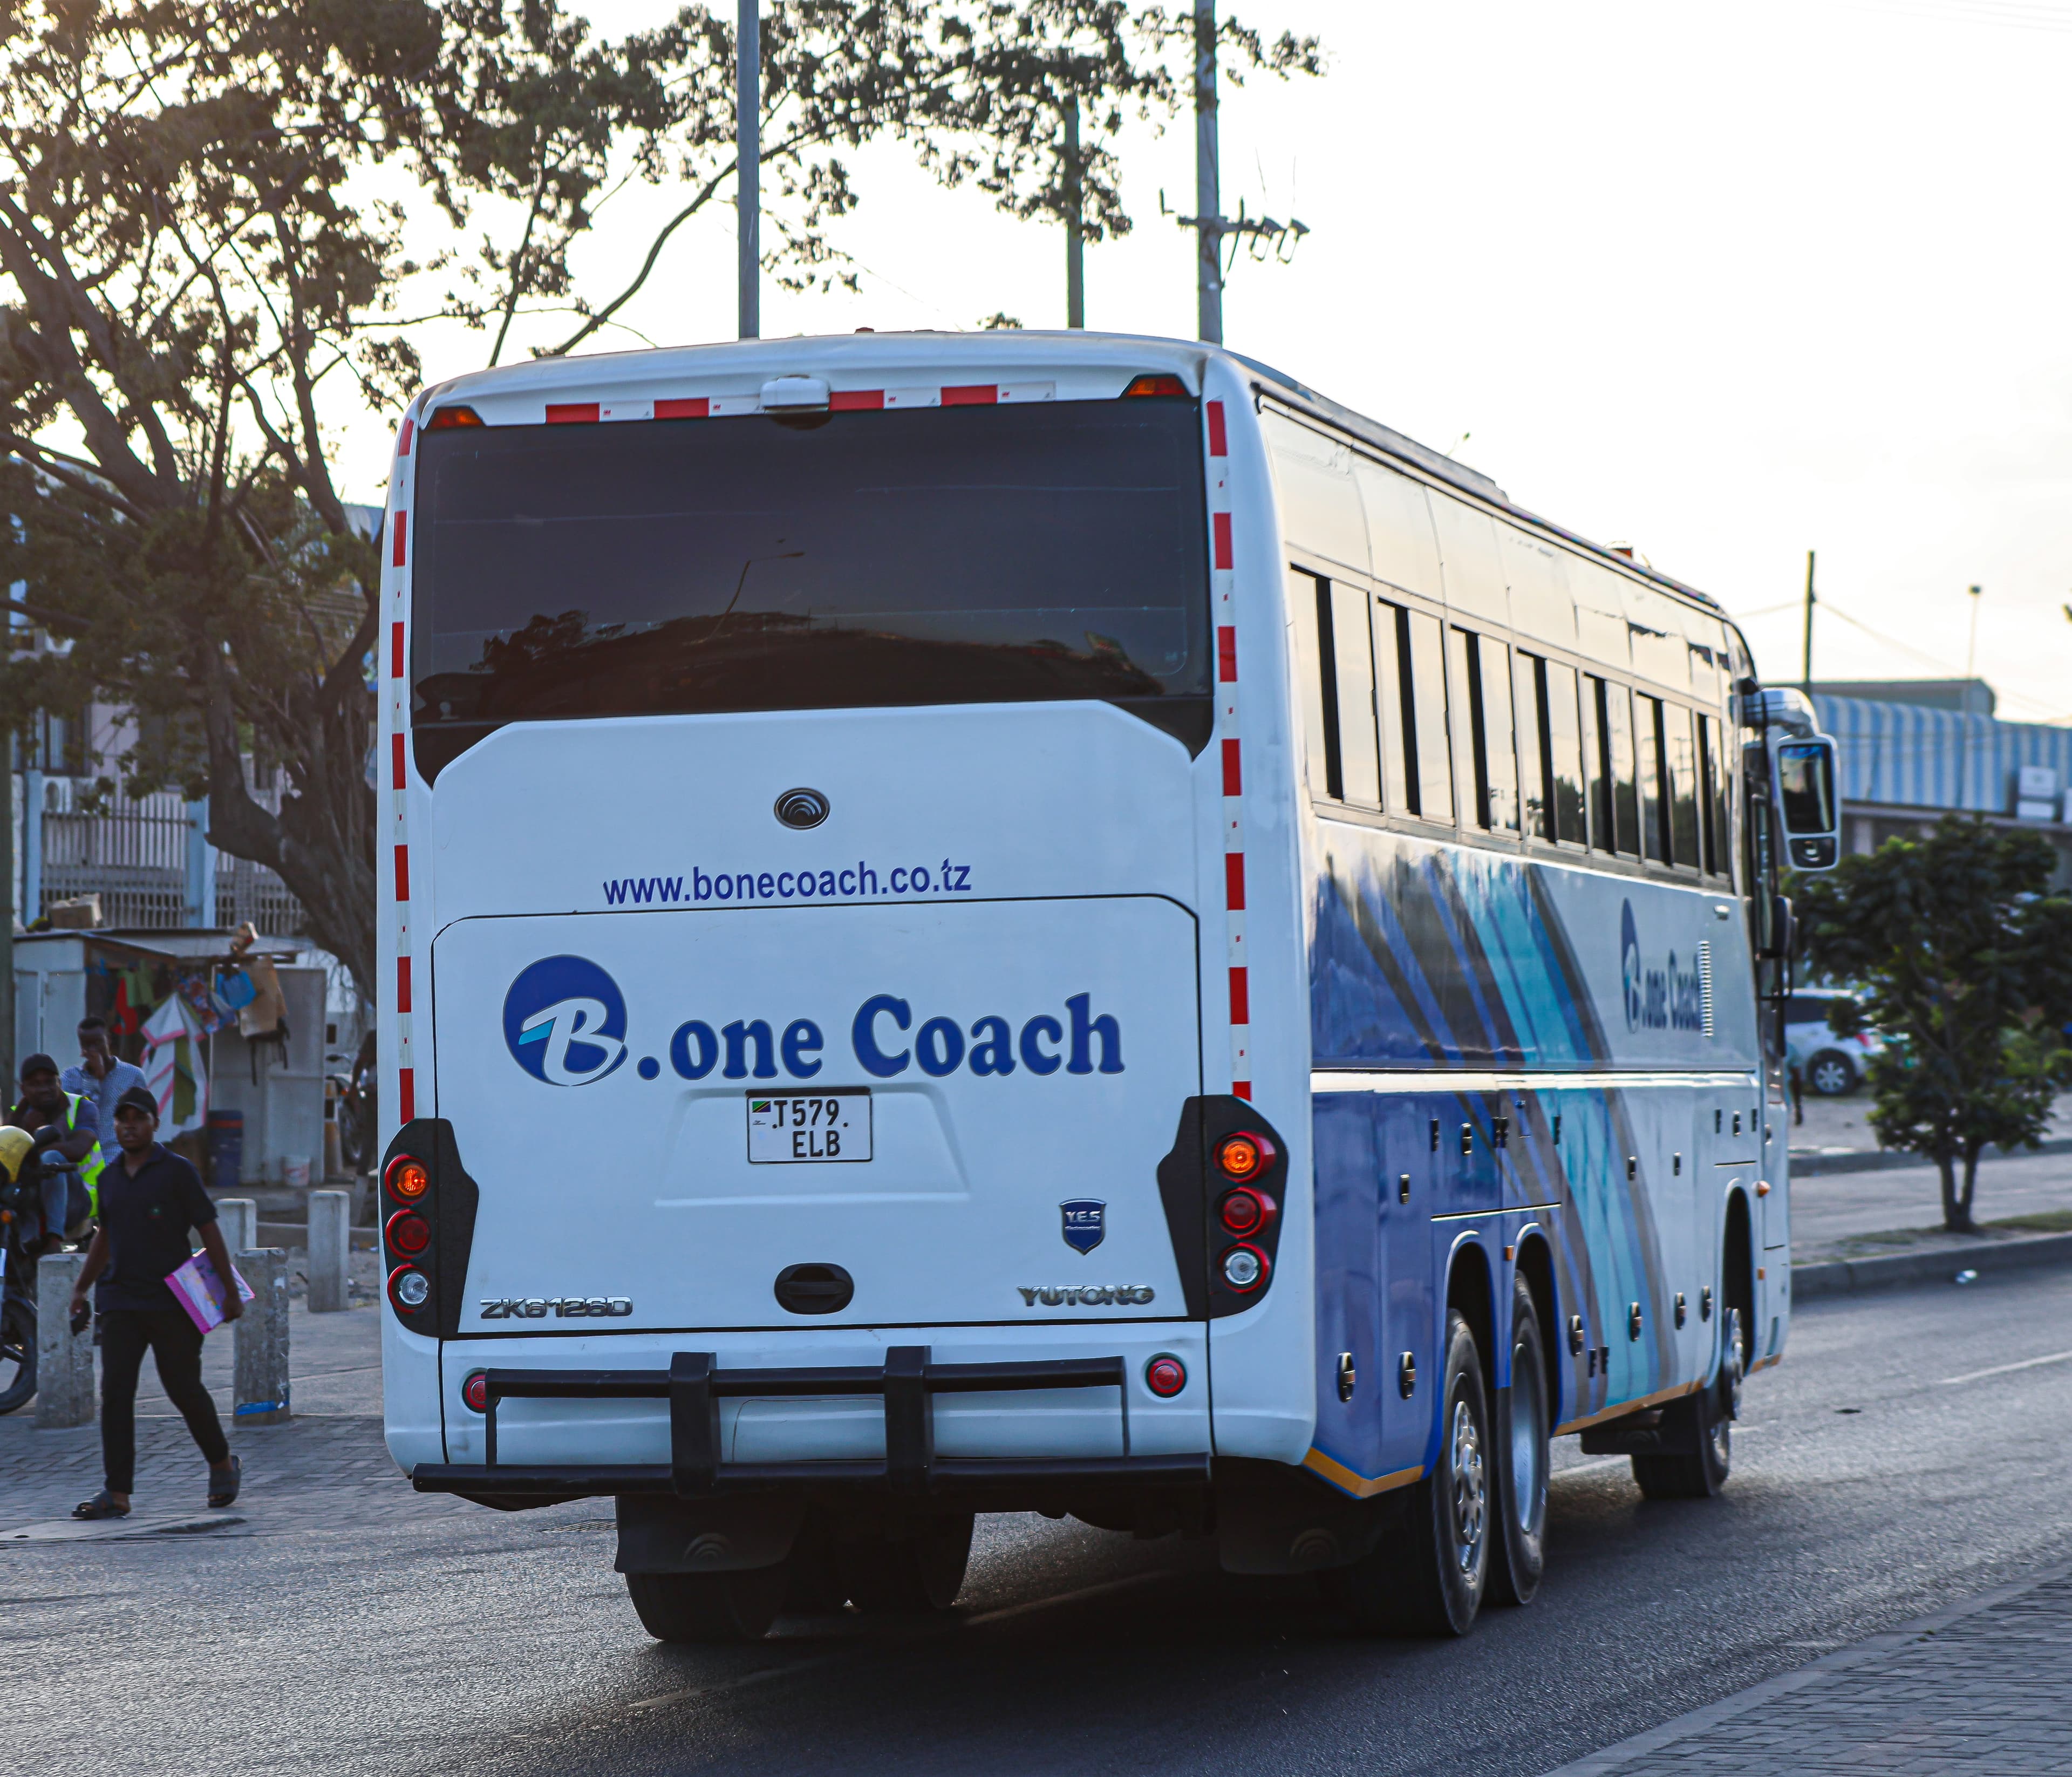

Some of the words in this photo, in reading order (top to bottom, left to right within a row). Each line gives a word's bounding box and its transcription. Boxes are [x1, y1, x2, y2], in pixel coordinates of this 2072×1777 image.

[602, 857, 972, 905] www.bonecoach.co.tz
[851, 992, 1126, 1079] Coach
[793, 1130, 841, 1158] ELB
[479, 1296, 633, 1319] ZK6126D
[1017, 1284, 1155, 1306] YUTONG
